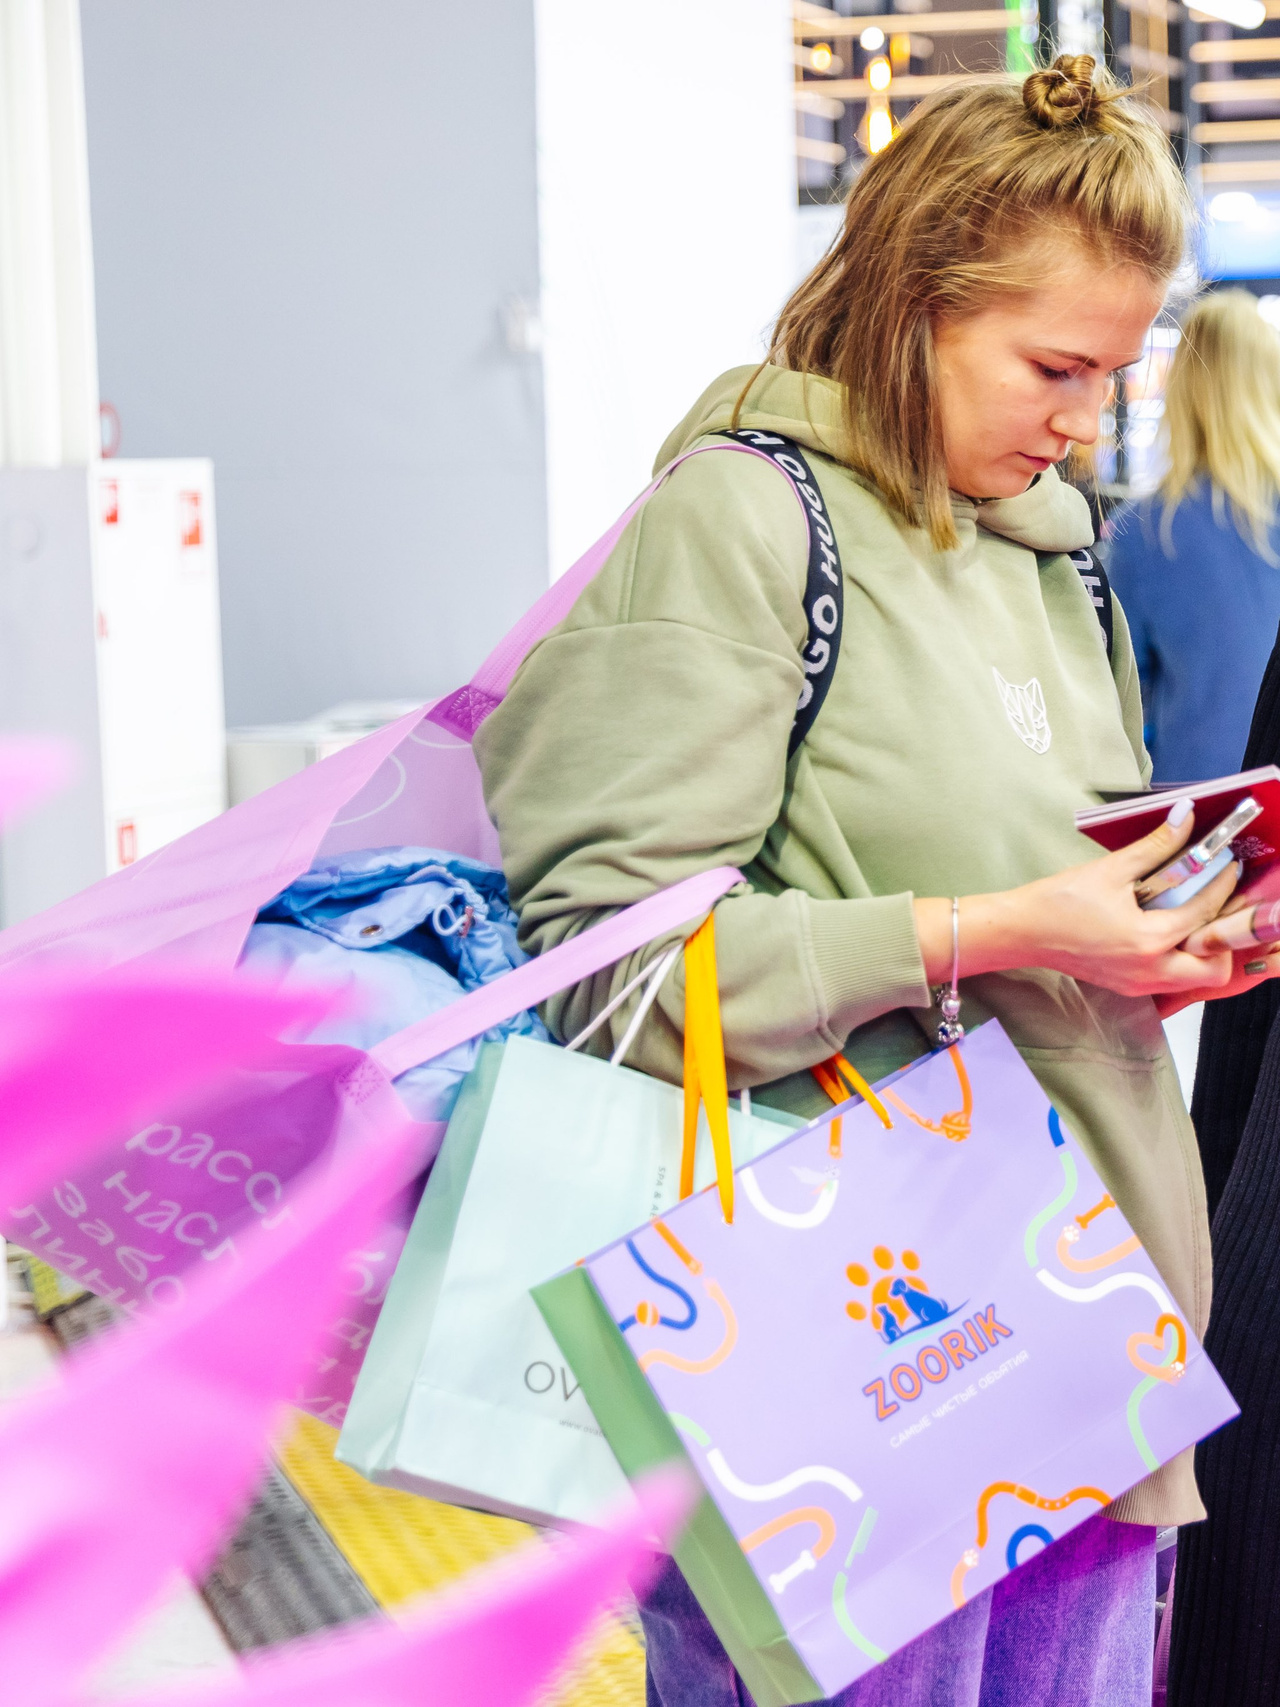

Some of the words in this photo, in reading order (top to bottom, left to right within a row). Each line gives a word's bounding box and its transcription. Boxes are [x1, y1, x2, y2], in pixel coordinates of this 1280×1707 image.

[774, 452, 839, 587] HUGO
[861, 1302, 1014, 1422] ZOORIK
[889, 1414, 932, 1449] САМЫЕ
[931, 1383, 978, 1419] ЧИСТЫЕ
